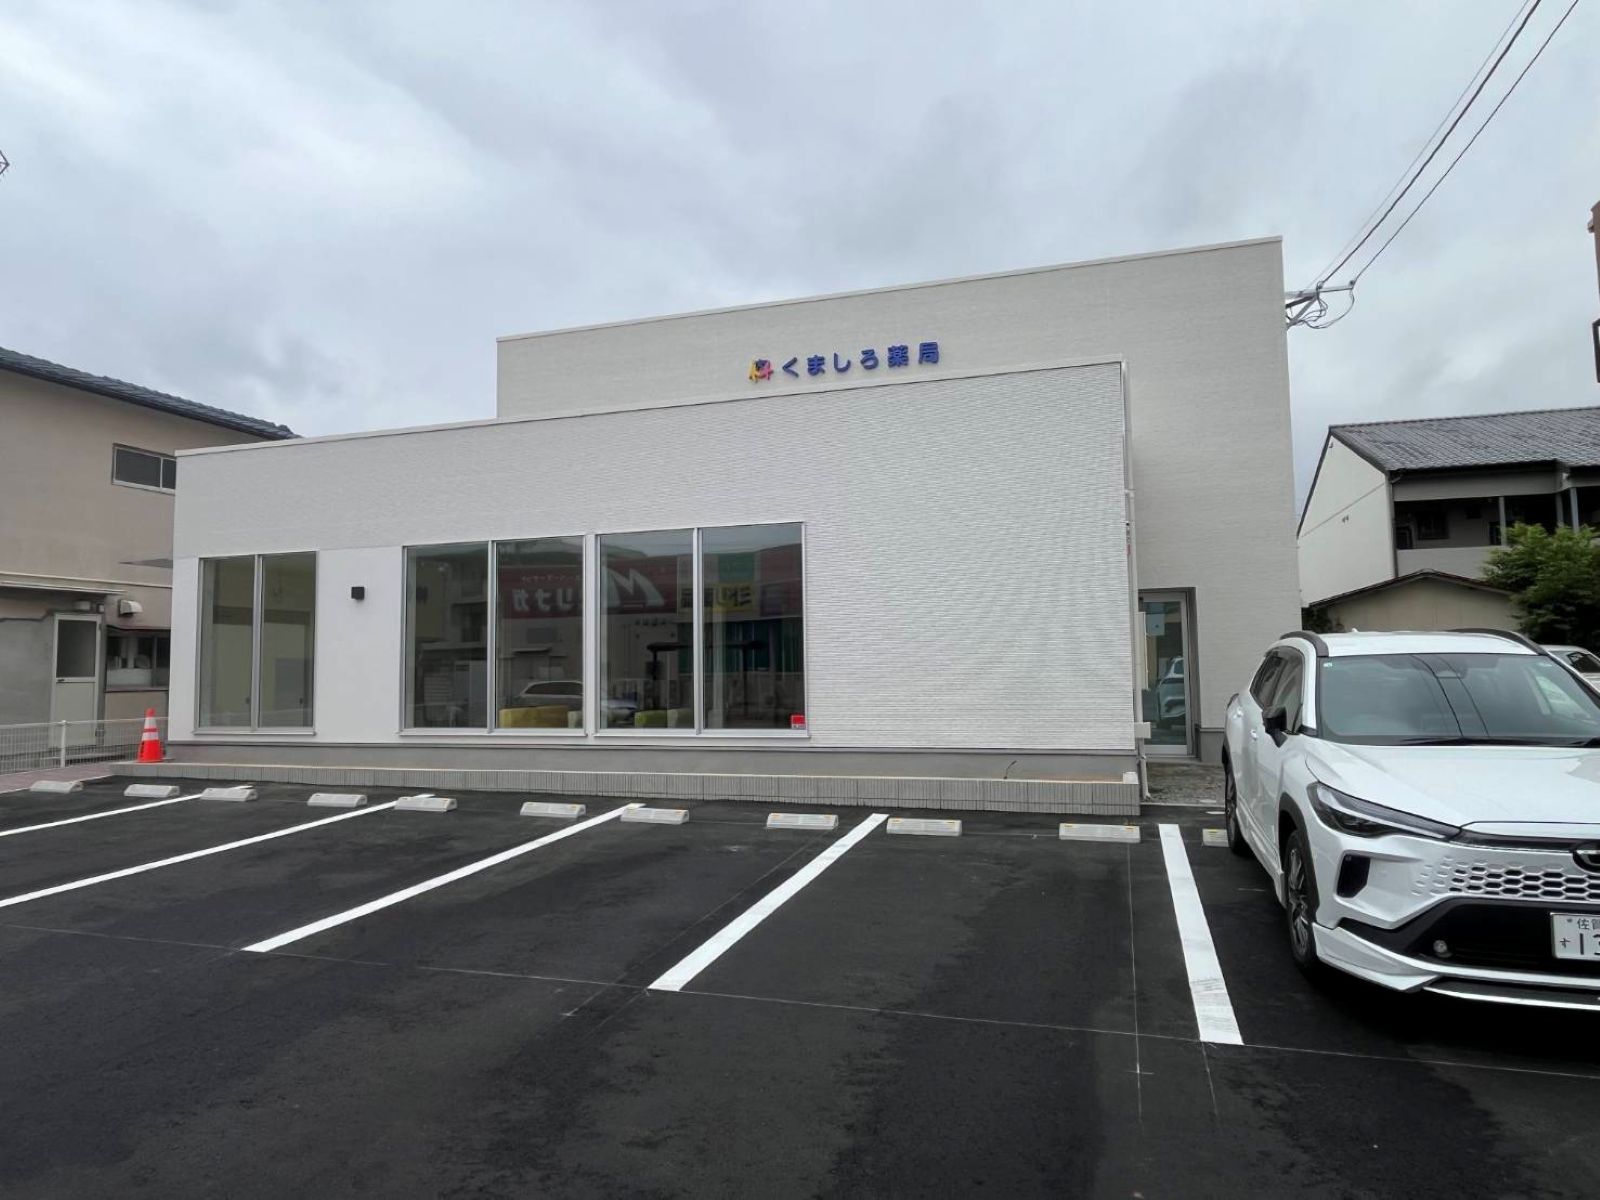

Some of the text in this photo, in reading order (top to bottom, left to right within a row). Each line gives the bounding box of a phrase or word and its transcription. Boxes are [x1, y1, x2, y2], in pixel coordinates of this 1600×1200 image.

[782, 341, 939, 378] くましろ薬局
